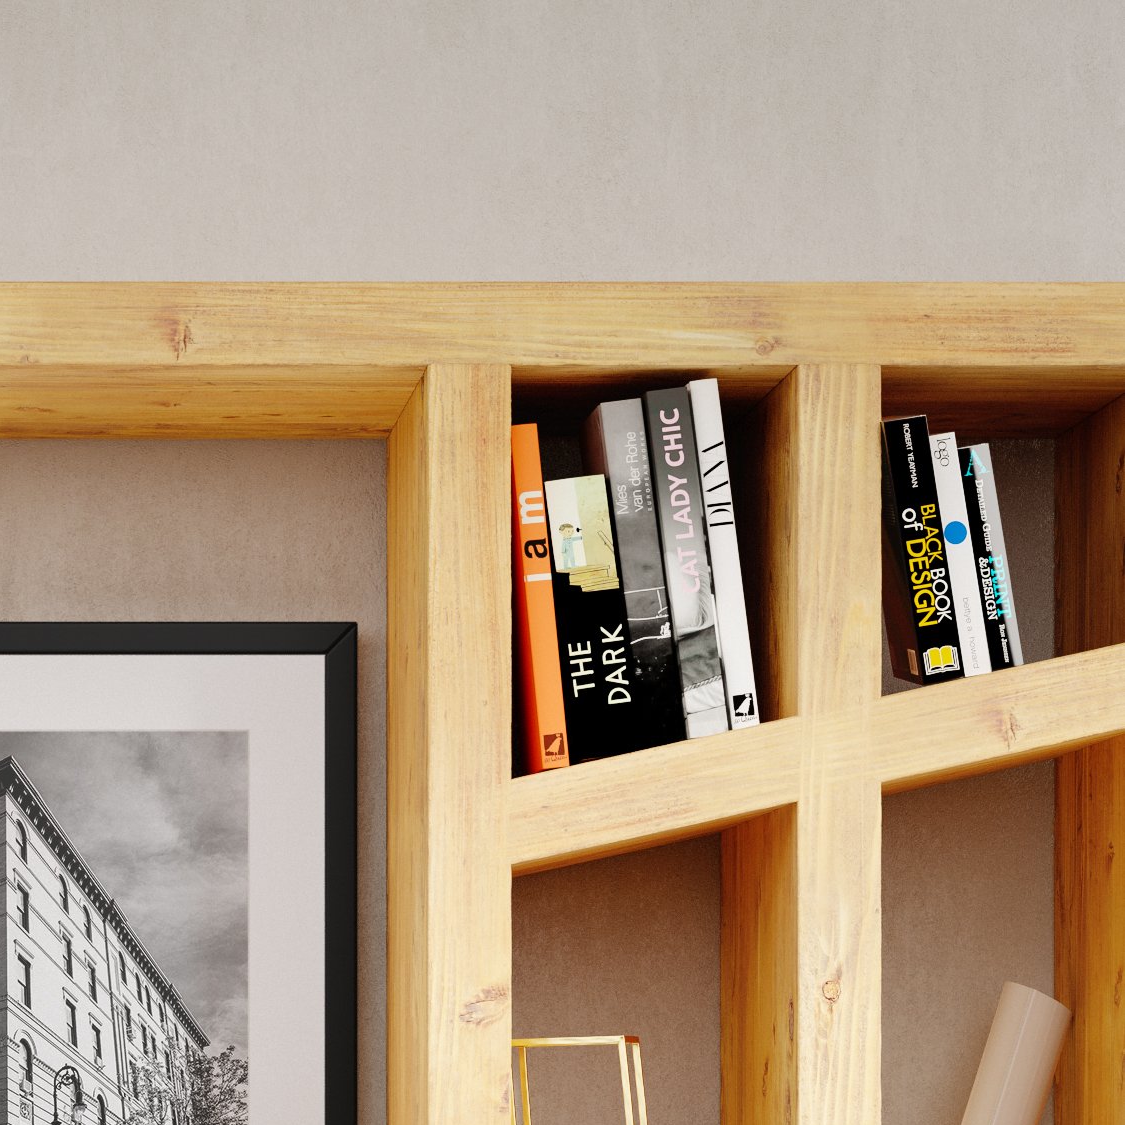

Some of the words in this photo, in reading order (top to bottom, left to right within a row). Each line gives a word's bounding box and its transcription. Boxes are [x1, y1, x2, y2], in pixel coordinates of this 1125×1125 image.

[625, 431, 639, 464] Rohe
[660, 408, 685, 468] CHIC
[902, 423, 913, 451] ROBERT
[963, 448, 990, 477] A
[628, 466, 641, 487] der
[632, 489, 644, 513] van
[668, 474, 694, 542] LADY
[901, 507, 924, 532] of
[920, 503, 945, 564] BLACK
[675, 547, 700, 594] CAT
[906, 538, 938, 628] DESIGN
[929, 568, 952, 624] BOOK
[988, 554, 1013, 619] PRINT
[568, 640, 596, 697] THE
[600, 623, 632, 704] DARK
